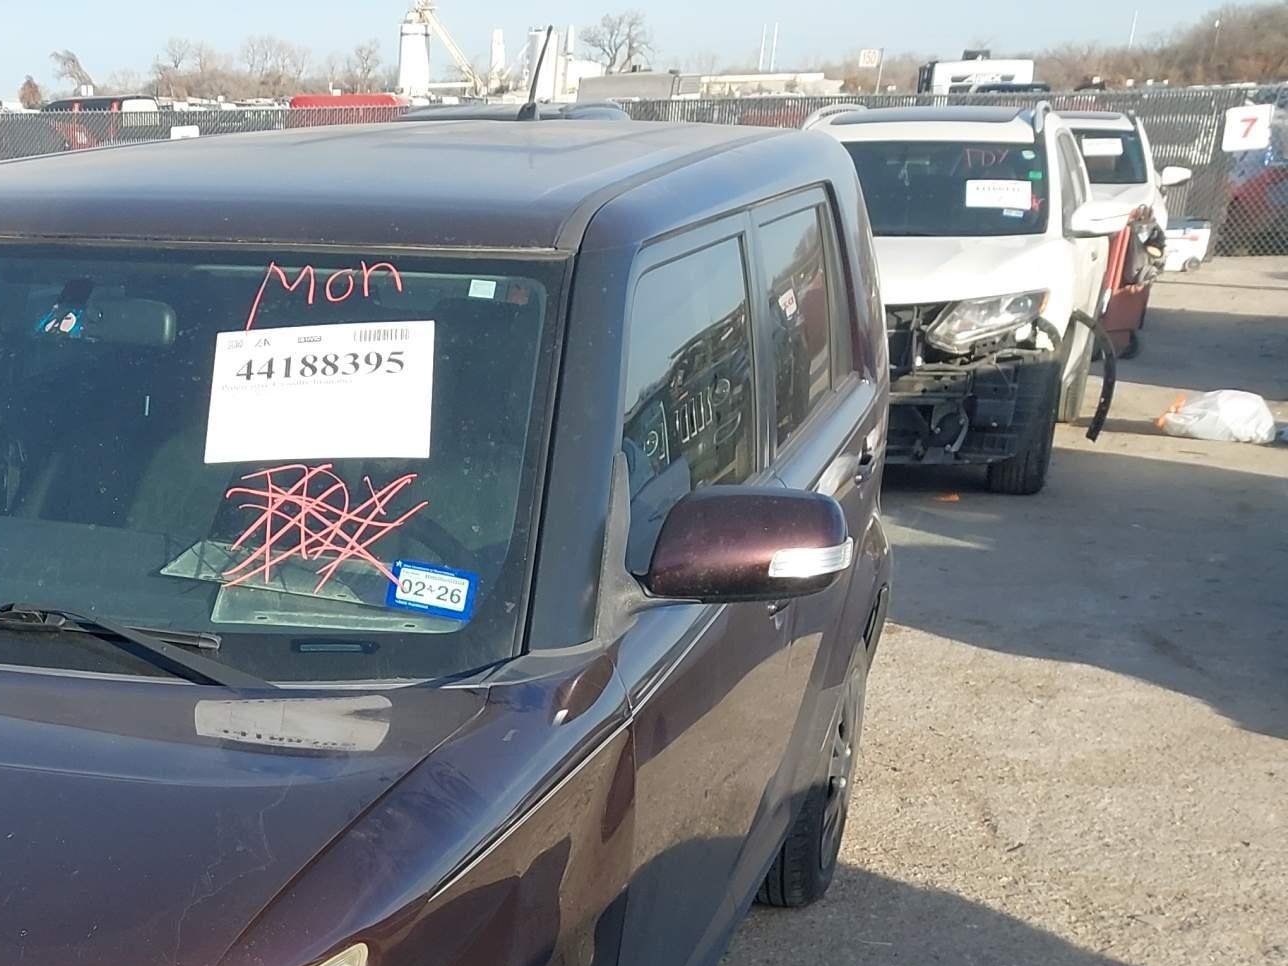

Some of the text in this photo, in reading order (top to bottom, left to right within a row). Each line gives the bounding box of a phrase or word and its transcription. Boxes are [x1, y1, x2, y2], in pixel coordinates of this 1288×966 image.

[1240, 116, 1258, 138] 7
[245, 261, 403, 333] Mon
[235, 350, 405, 381] 44188395
[435, 585, 463, 605] 26
